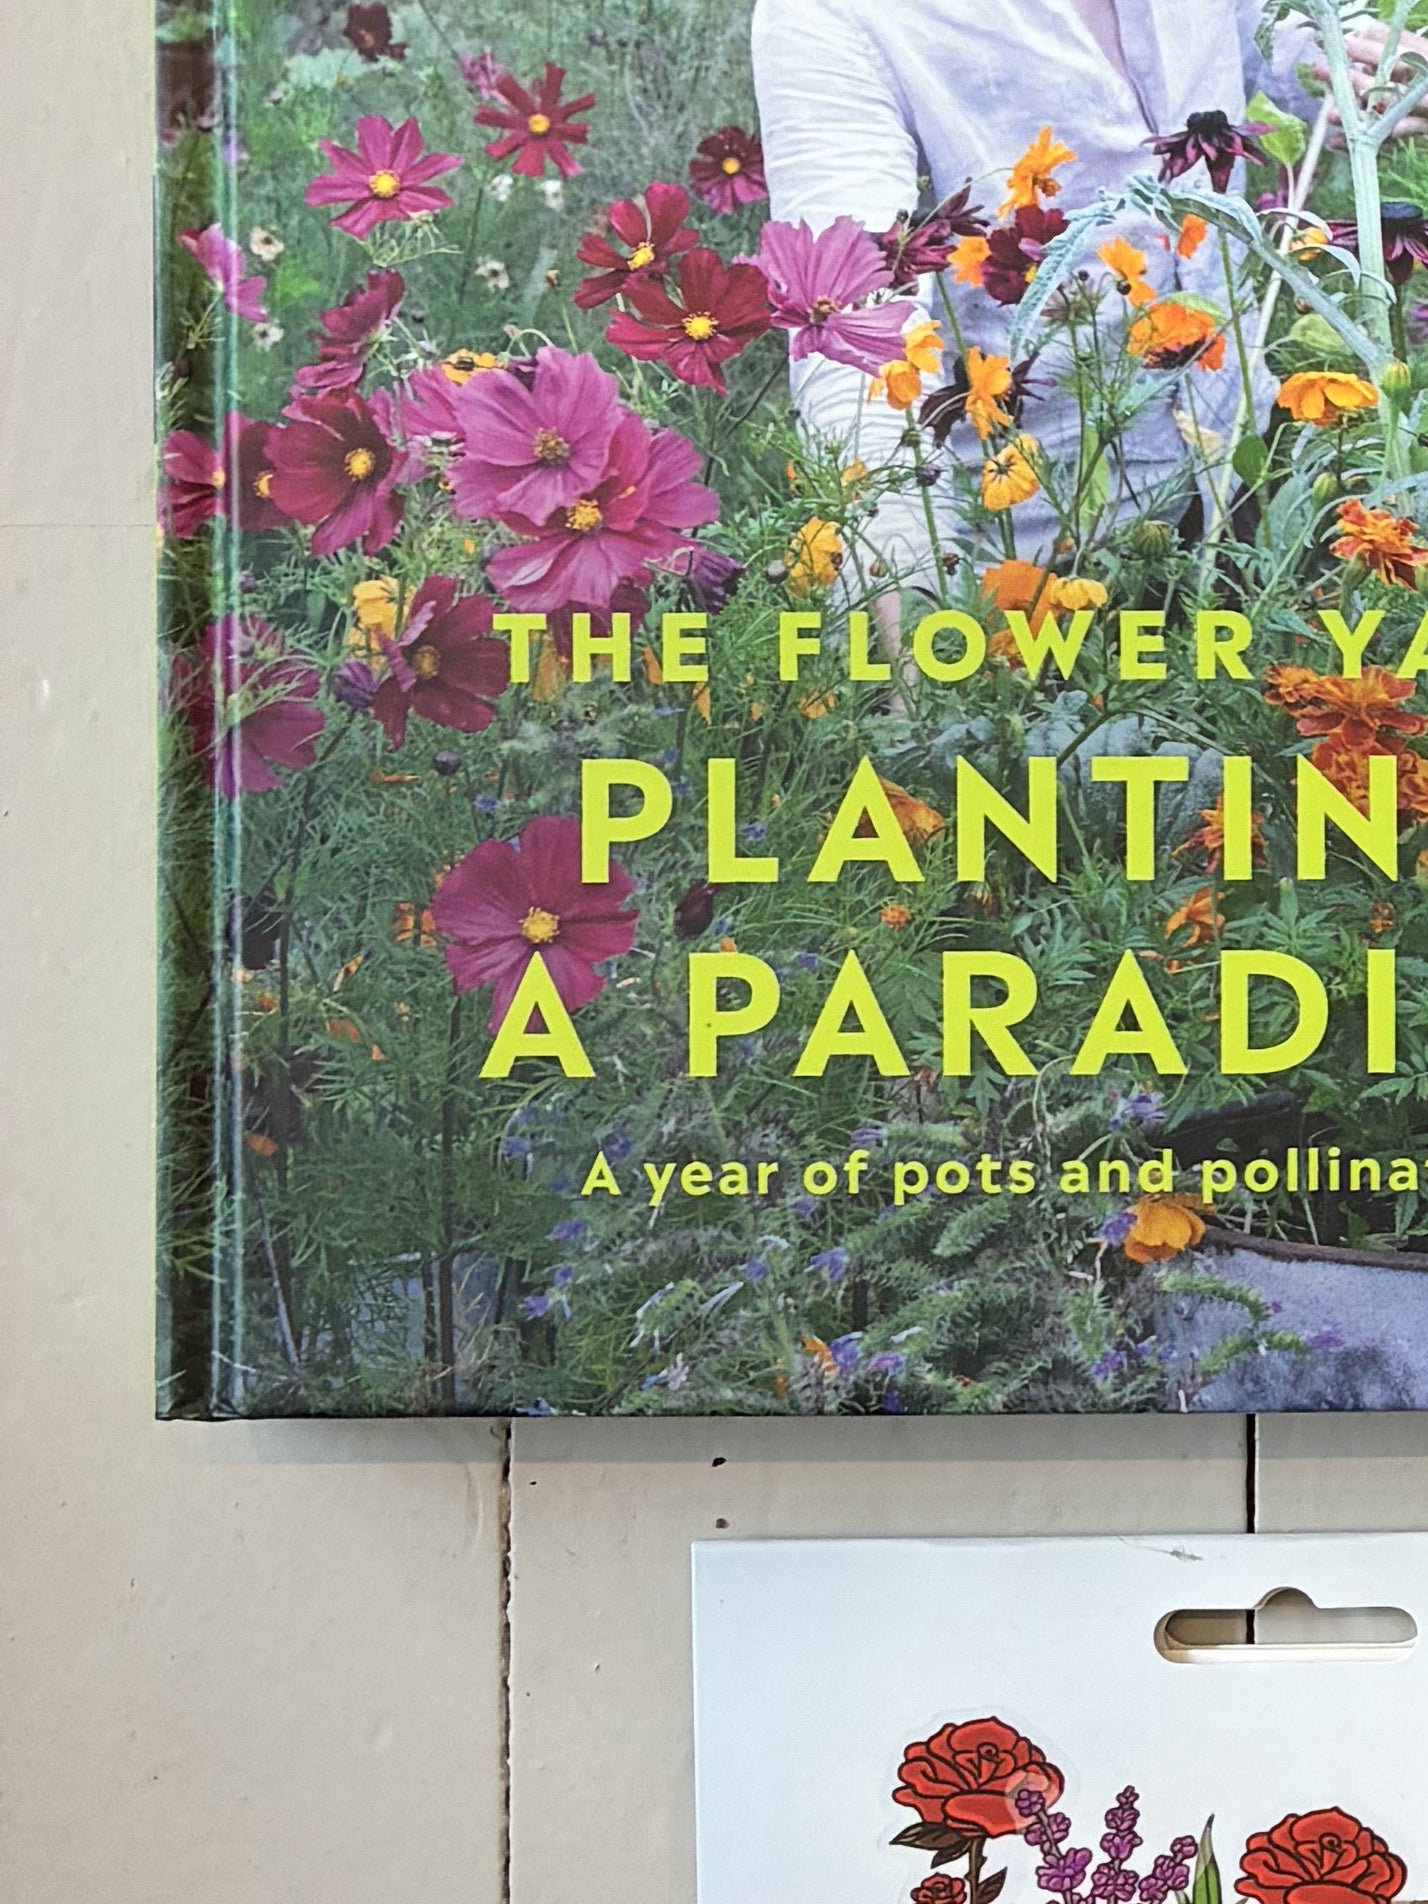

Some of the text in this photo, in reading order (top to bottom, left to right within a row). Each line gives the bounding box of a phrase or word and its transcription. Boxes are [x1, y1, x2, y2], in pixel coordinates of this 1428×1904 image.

[495, 613, 714, 682] THE
[779, 606, 1251, 681] FLOWER
[480, 954, 593, 1078] A
[581, 1155, 619, 1196] A
[644, 1154, 780, 1208] year
[803, 1151, 867, 1195] of
[893, 1156, 1034, 1205] pots
[1060, 1150, 1172, 1195] and
